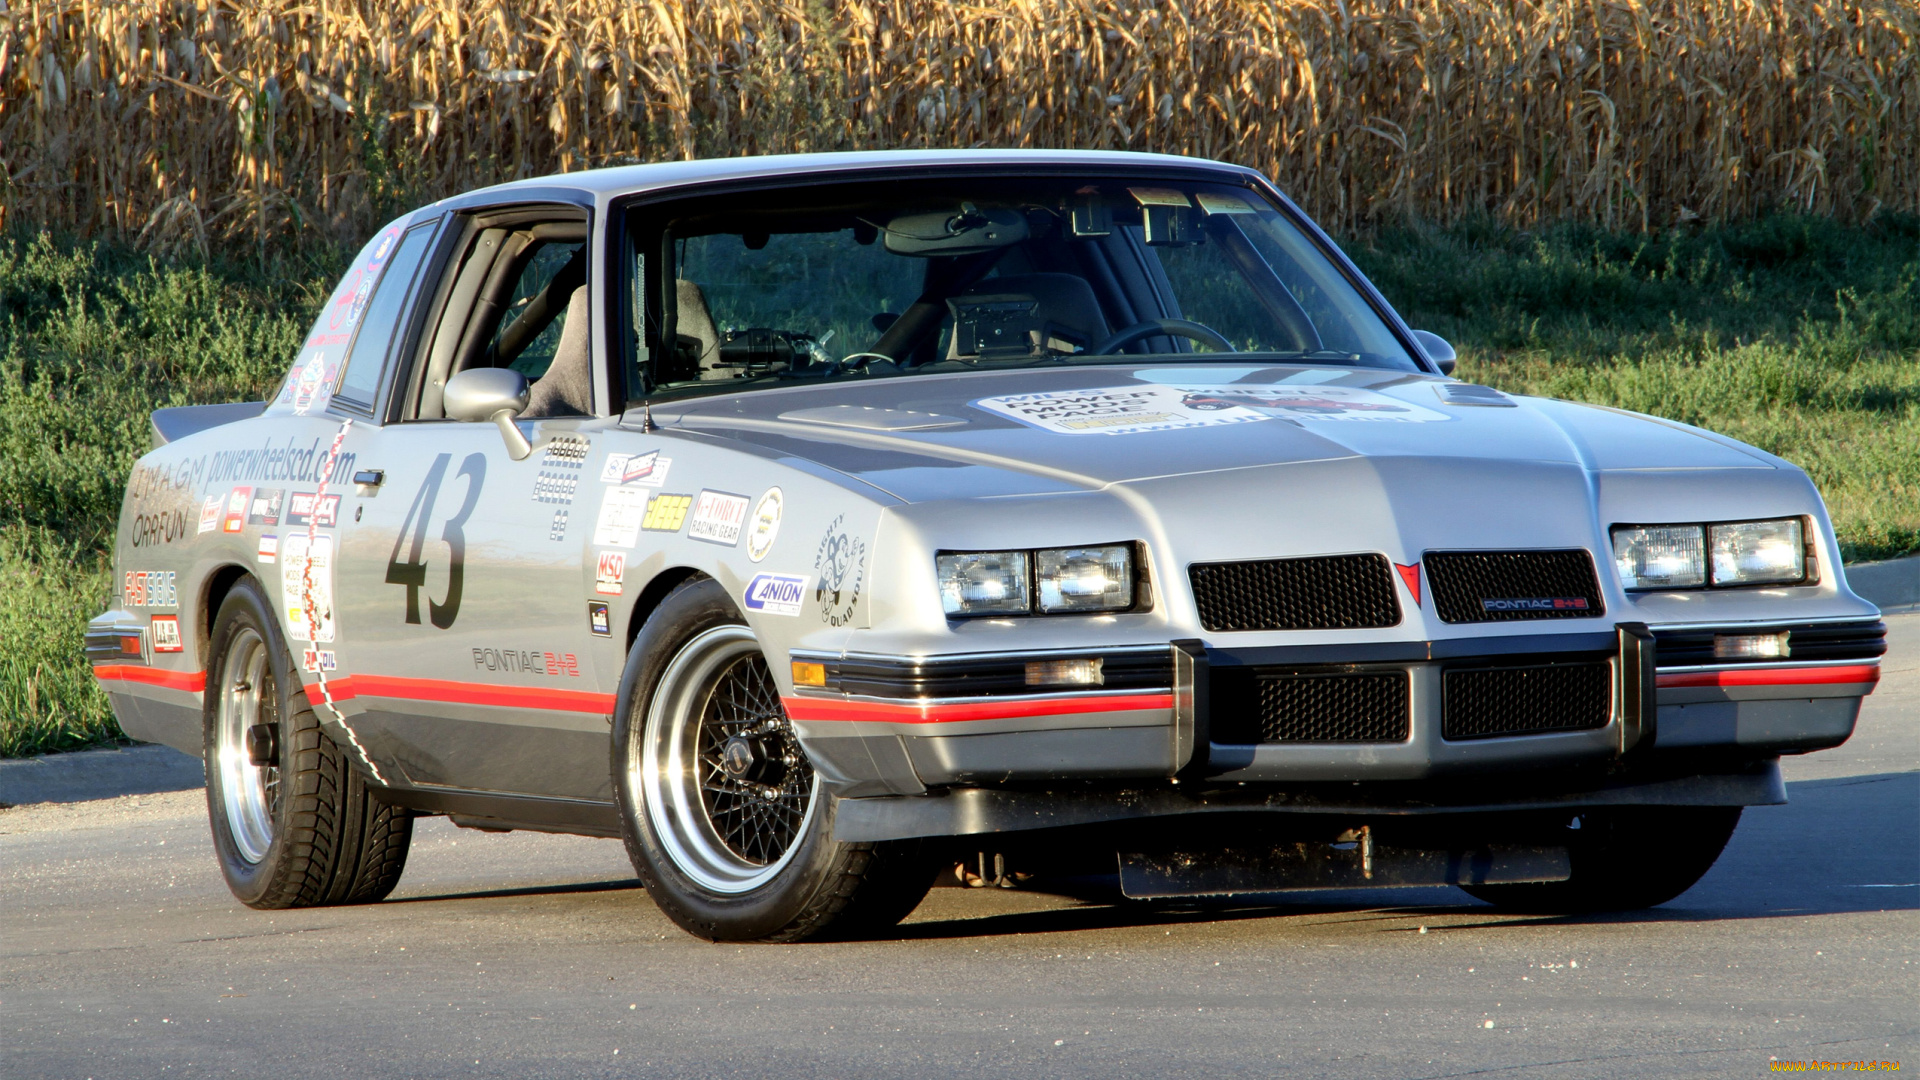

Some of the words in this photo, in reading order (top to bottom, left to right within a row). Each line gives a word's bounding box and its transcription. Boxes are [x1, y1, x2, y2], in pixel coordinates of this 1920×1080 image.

[992, 389, 1106, 403] WIL'S
[1006, 391, 1158, 408] POWER
[1021, 399, 1149, 414] MODS
[1037, 406, 1147, 419] PAGE
[696, 496, 746, 524] G-FORCE
[384, 452, 487, 630] 43
[691, 519, 719, 537] RACING
[718, 524, 739, 541] GEAR
[814, 512, 845, 570] MIGHTY
[598, 554, 623, 580] MSD
[125, 571, 178, 608] FASTSIGNS
[745, 575, 803, 609] CANTON
[830, 605, 854, 628] QUAD
[851, 542, 865, 608] SQUAD
[1484, 599, 1553, 610] PONTIAC
[1553, 598, 1587, 609] 2+2
[304, 651, 336, 671] AOIL
[472, 648, 544, 675] PONTIAC
[544, 651, 580, 677] 2+2
